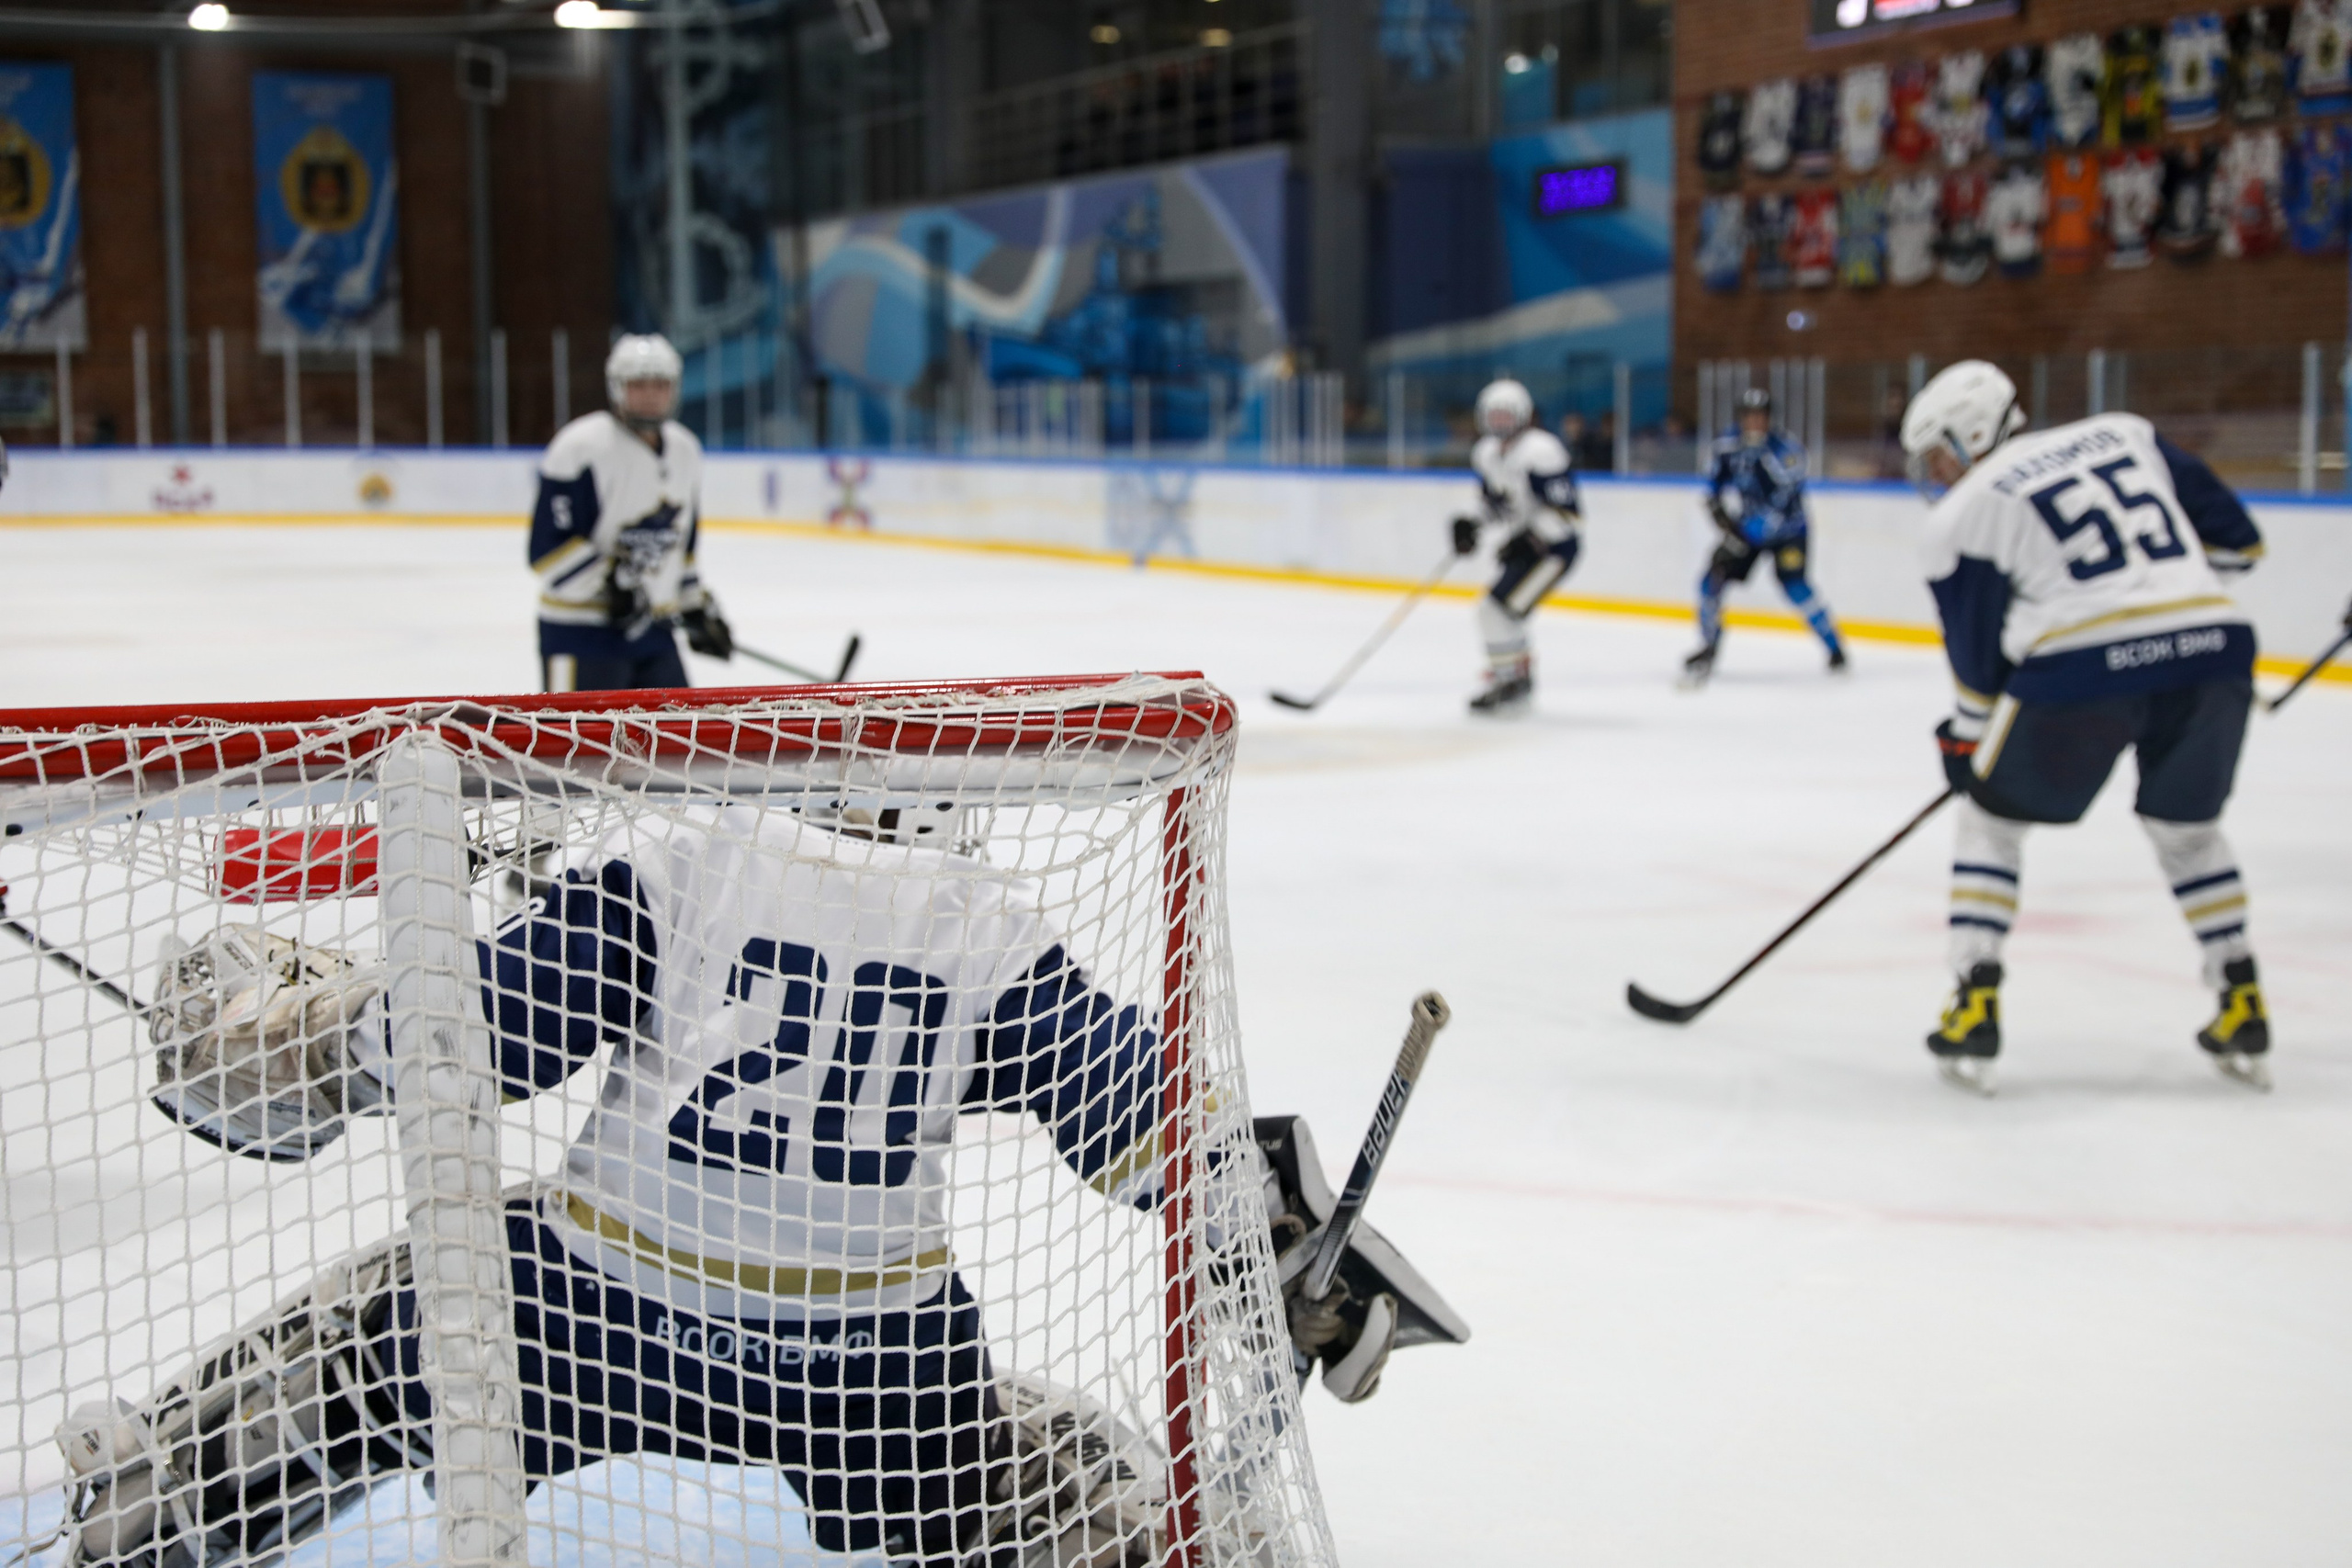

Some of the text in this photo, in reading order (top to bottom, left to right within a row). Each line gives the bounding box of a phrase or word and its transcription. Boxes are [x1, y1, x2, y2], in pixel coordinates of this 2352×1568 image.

[2030, 457, 2188, 581] 55
[2105, 636, 2175, 671] ВСОК
[668, 936, 949, 1189] 20
[654, 1315, 874, 1365] ВСОК ВМФ
